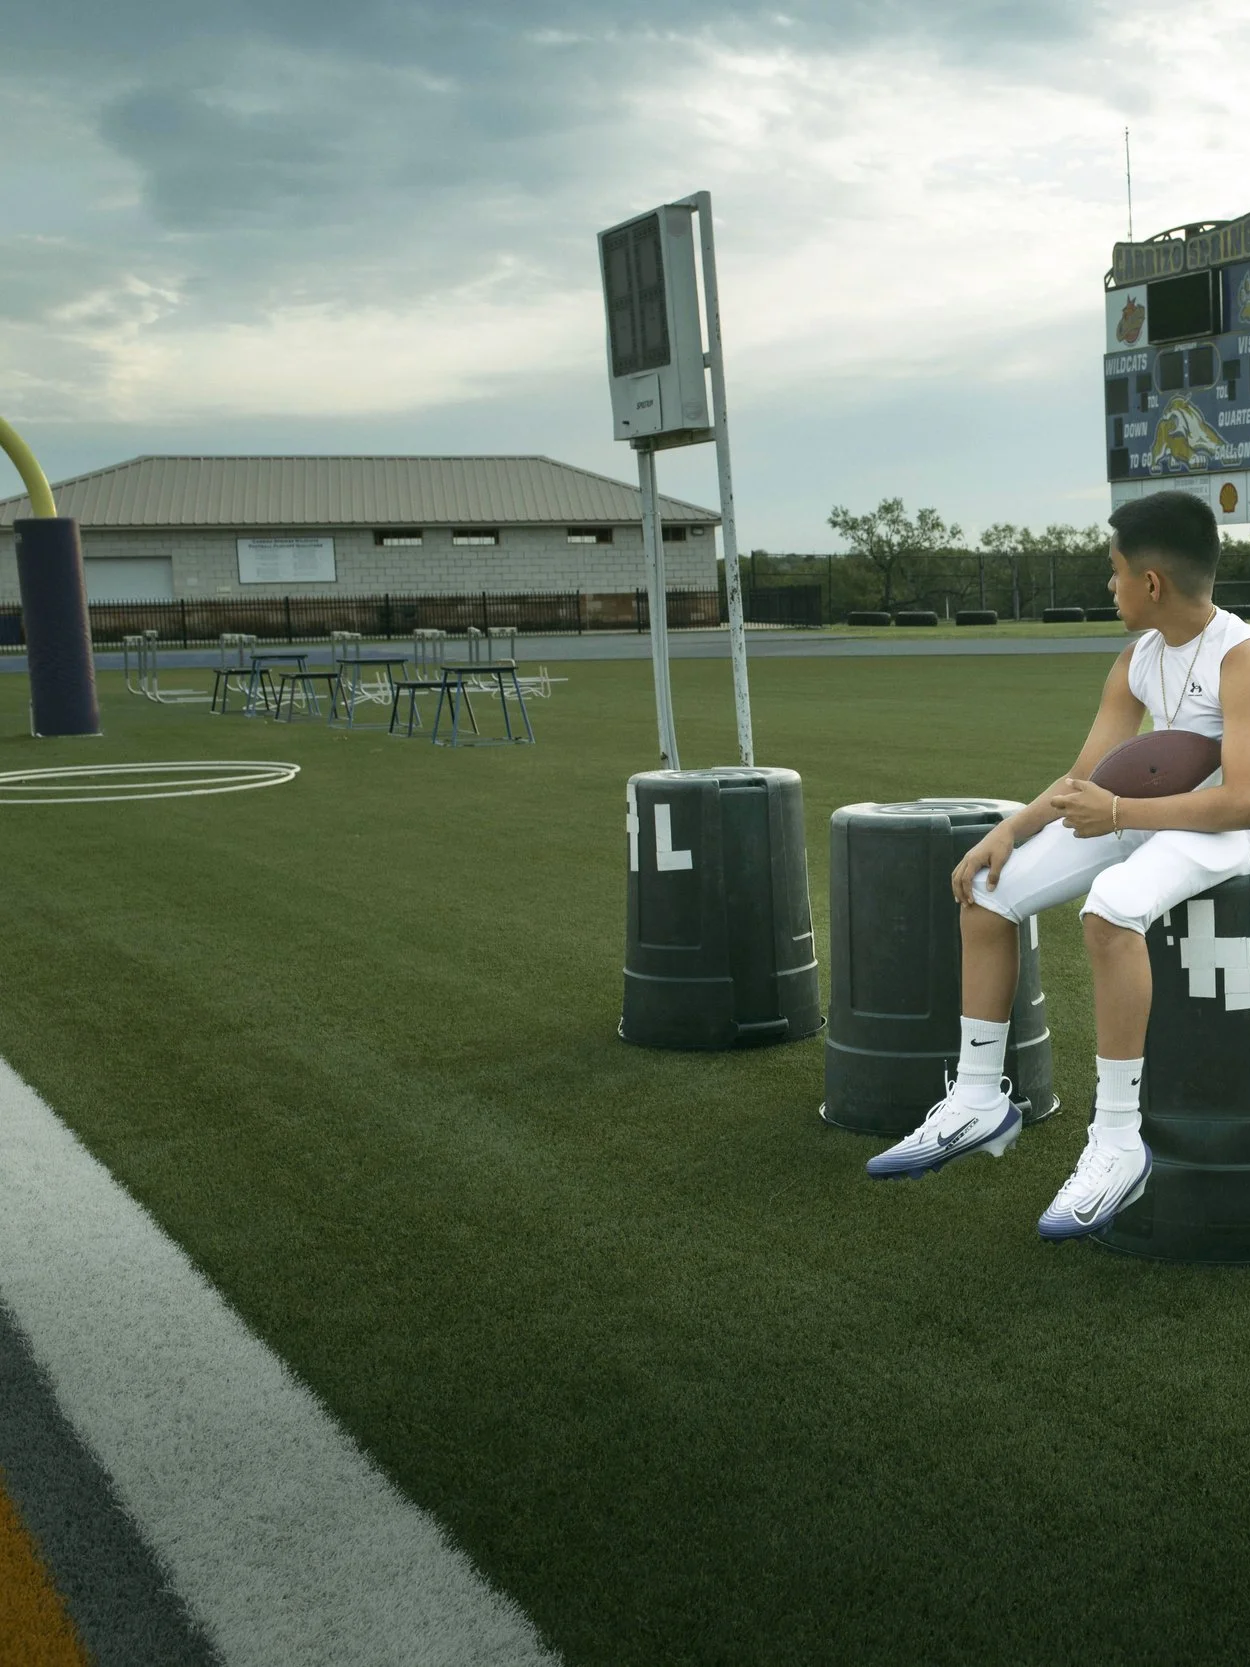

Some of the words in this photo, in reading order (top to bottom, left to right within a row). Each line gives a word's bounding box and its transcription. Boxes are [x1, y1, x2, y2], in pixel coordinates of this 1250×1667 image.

[1105, 353, 1148, 376] WILDCATS
[1124, 422, 1148, 438] DOWN
[1130, 454, 1140, 469] TO
[1141, 451, 1153, 467] GO
